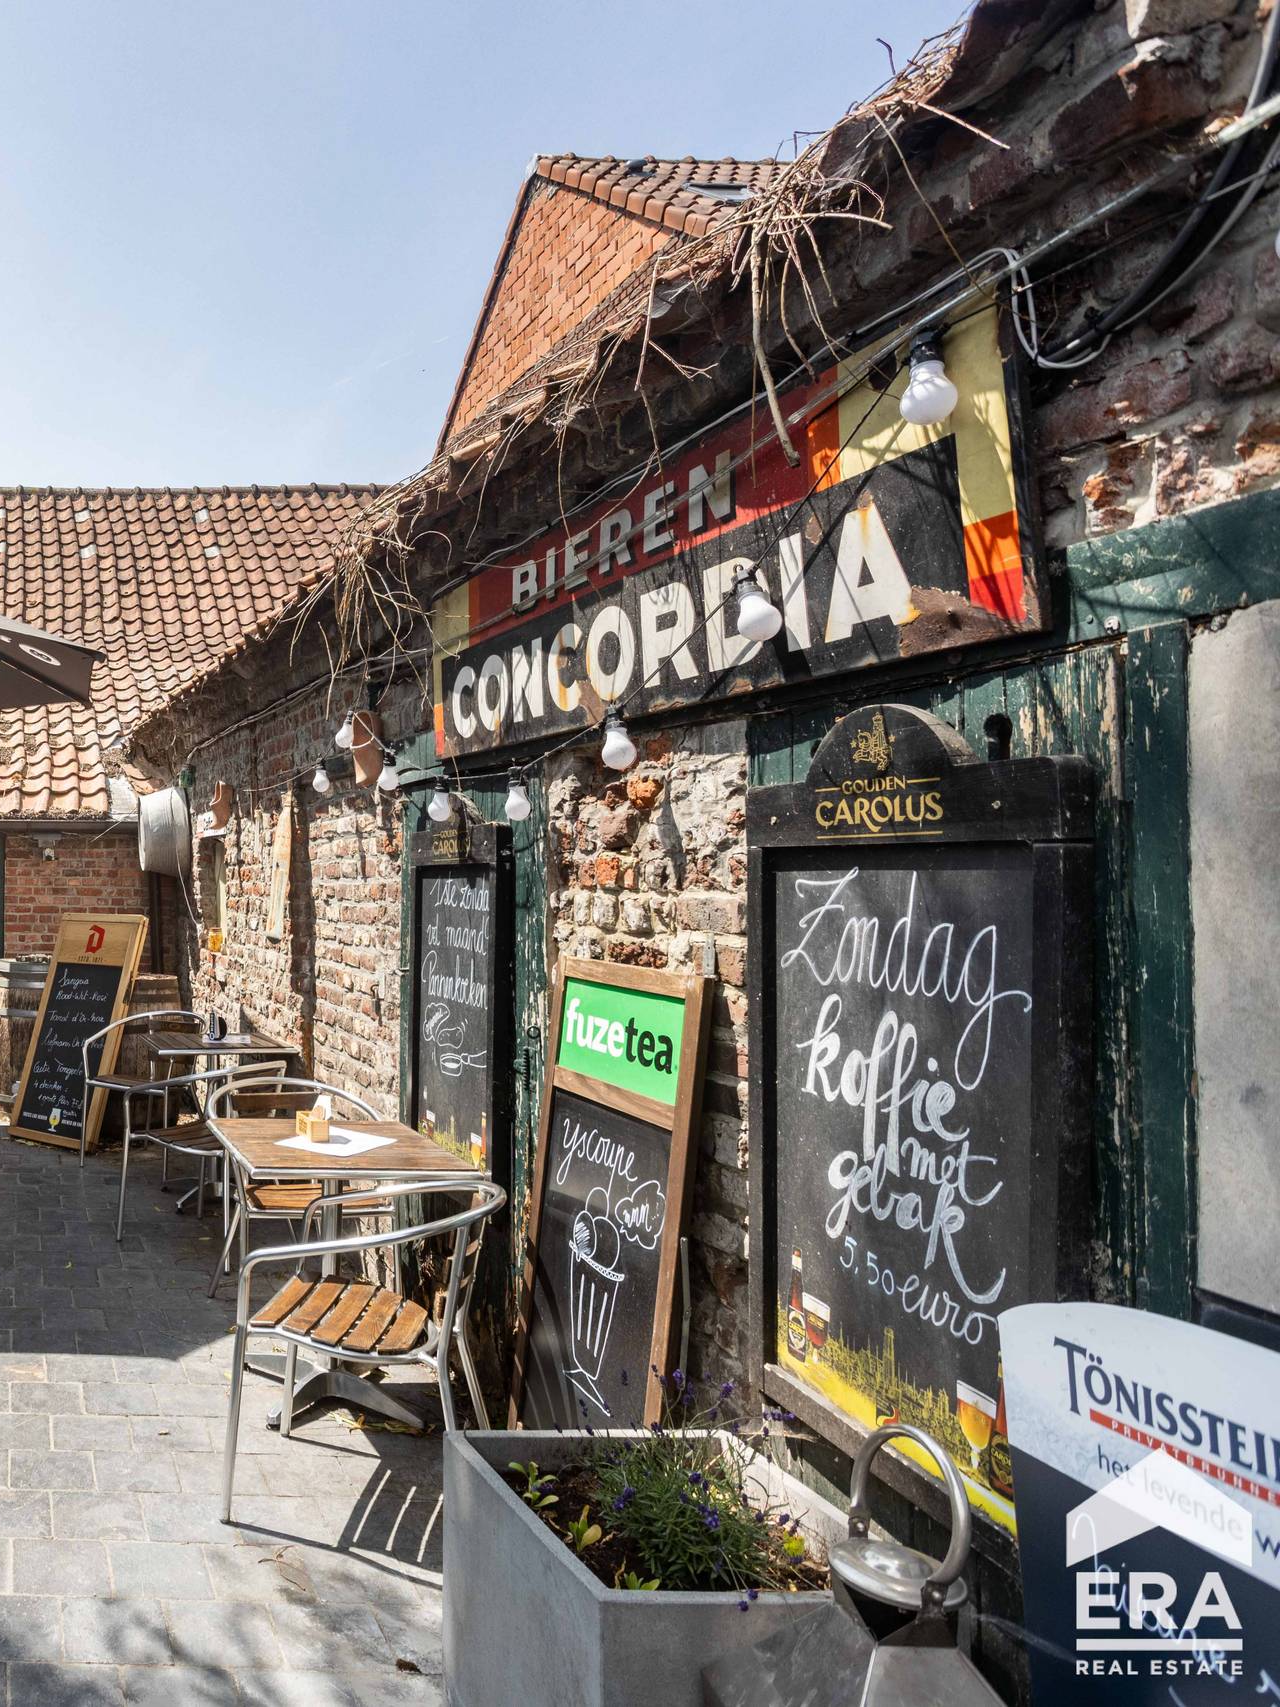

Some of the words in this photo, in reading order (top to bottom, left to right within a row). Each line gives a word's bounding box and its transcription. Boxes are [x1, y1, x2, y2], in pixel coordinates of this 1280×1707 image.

[511, 449, 737, 611] BIEREN
[452, 501, 917, 740] CONCORDIA
[815, 791, 944, 833] CAROLUS
[841, 775, 907, 795] GOUDEN
[85, 924, 106, 954] D
[445, 915, 487, 956] maand
[781, 866, 1033, 1091] Zondag
[566, 997, 673, 1075] fuzetea
[797, 993, 969, 1177] koffie
[900, 1135, 1003, 1207] met
[825, 1143, 1006, 1304] gebak
